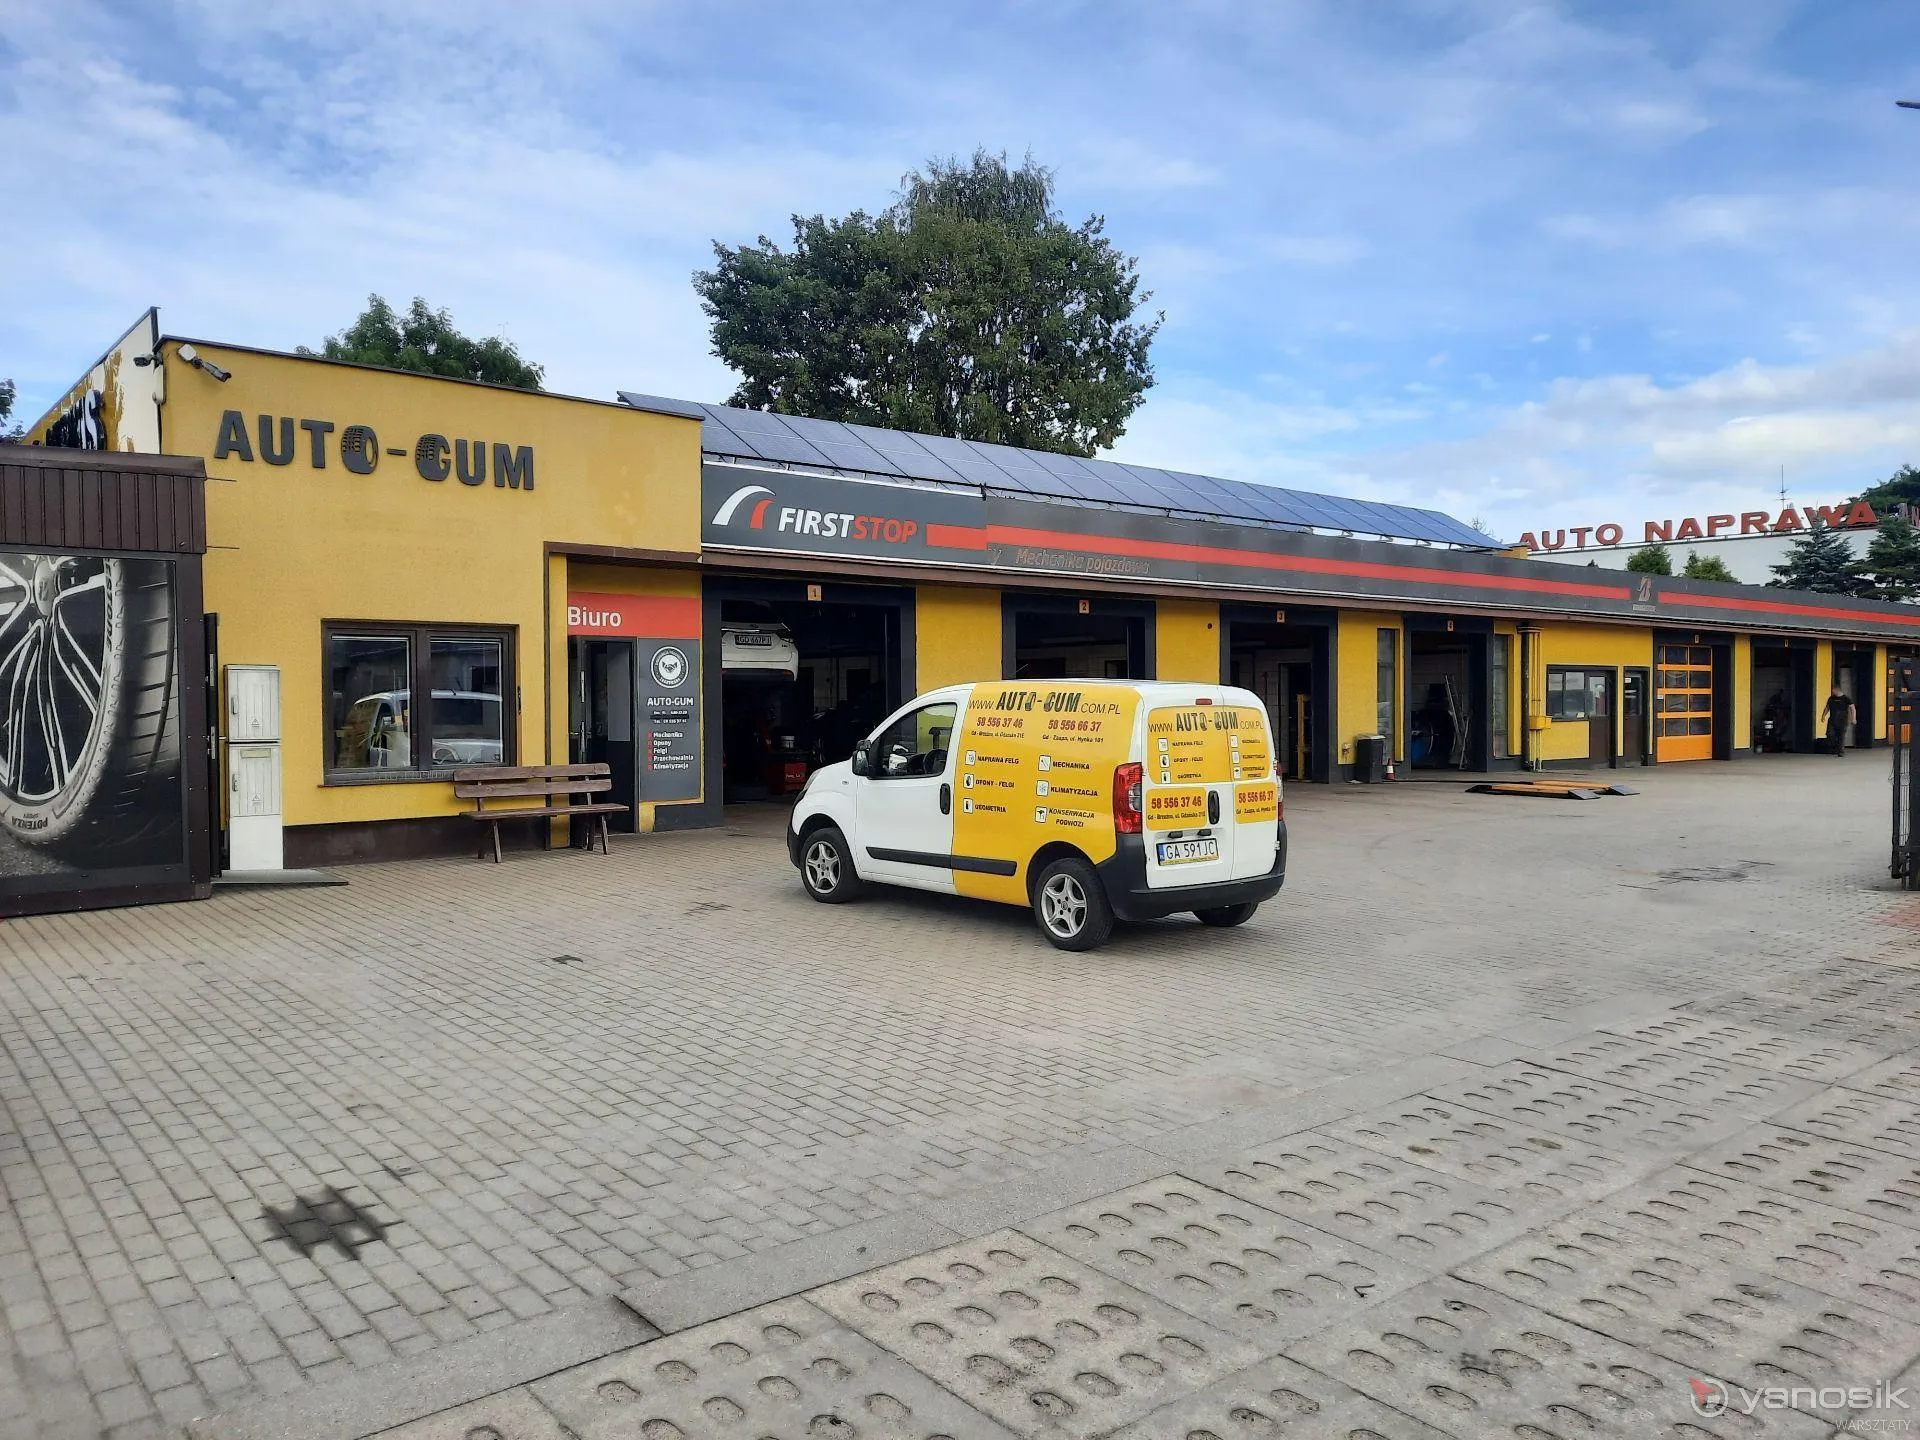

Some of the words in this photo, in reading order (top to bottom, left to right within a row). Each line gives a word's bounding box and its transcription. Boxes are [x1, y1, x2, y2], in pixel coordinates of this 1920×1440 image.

[213, 409, 535, 490] AUTO-GUM
[1519, 523, 1624, 551] AUTO
[1645, 501, 1879, 542] NAPRAWA
[104, 557, 113, 652] ESTONE
[567, 606, 622, 627] Biuro
[647, 697, 694, 706] AUTO-GUM
[1002, 718, 1012, 728] 37
[1013, 718, 1023, 729] 46
[1090, 721, 1102, 732] 37
[977, 755, 1004, 764] NAPRAWA
[1052, 761, 1090, 770] MECHANIKA
[1050, 786, 1098, 796] KLIMATYZACJA
[1151, 797, 1162, 809] 58
[1163, 797, 1179, 809] 556
[1180, 796, 1190, 808] 37
[1048, 807, 1095, 819] KONSERWACJA
[1166, 844, 1181, 860] GA
[1183, 841, 1215, 858] 591JC
